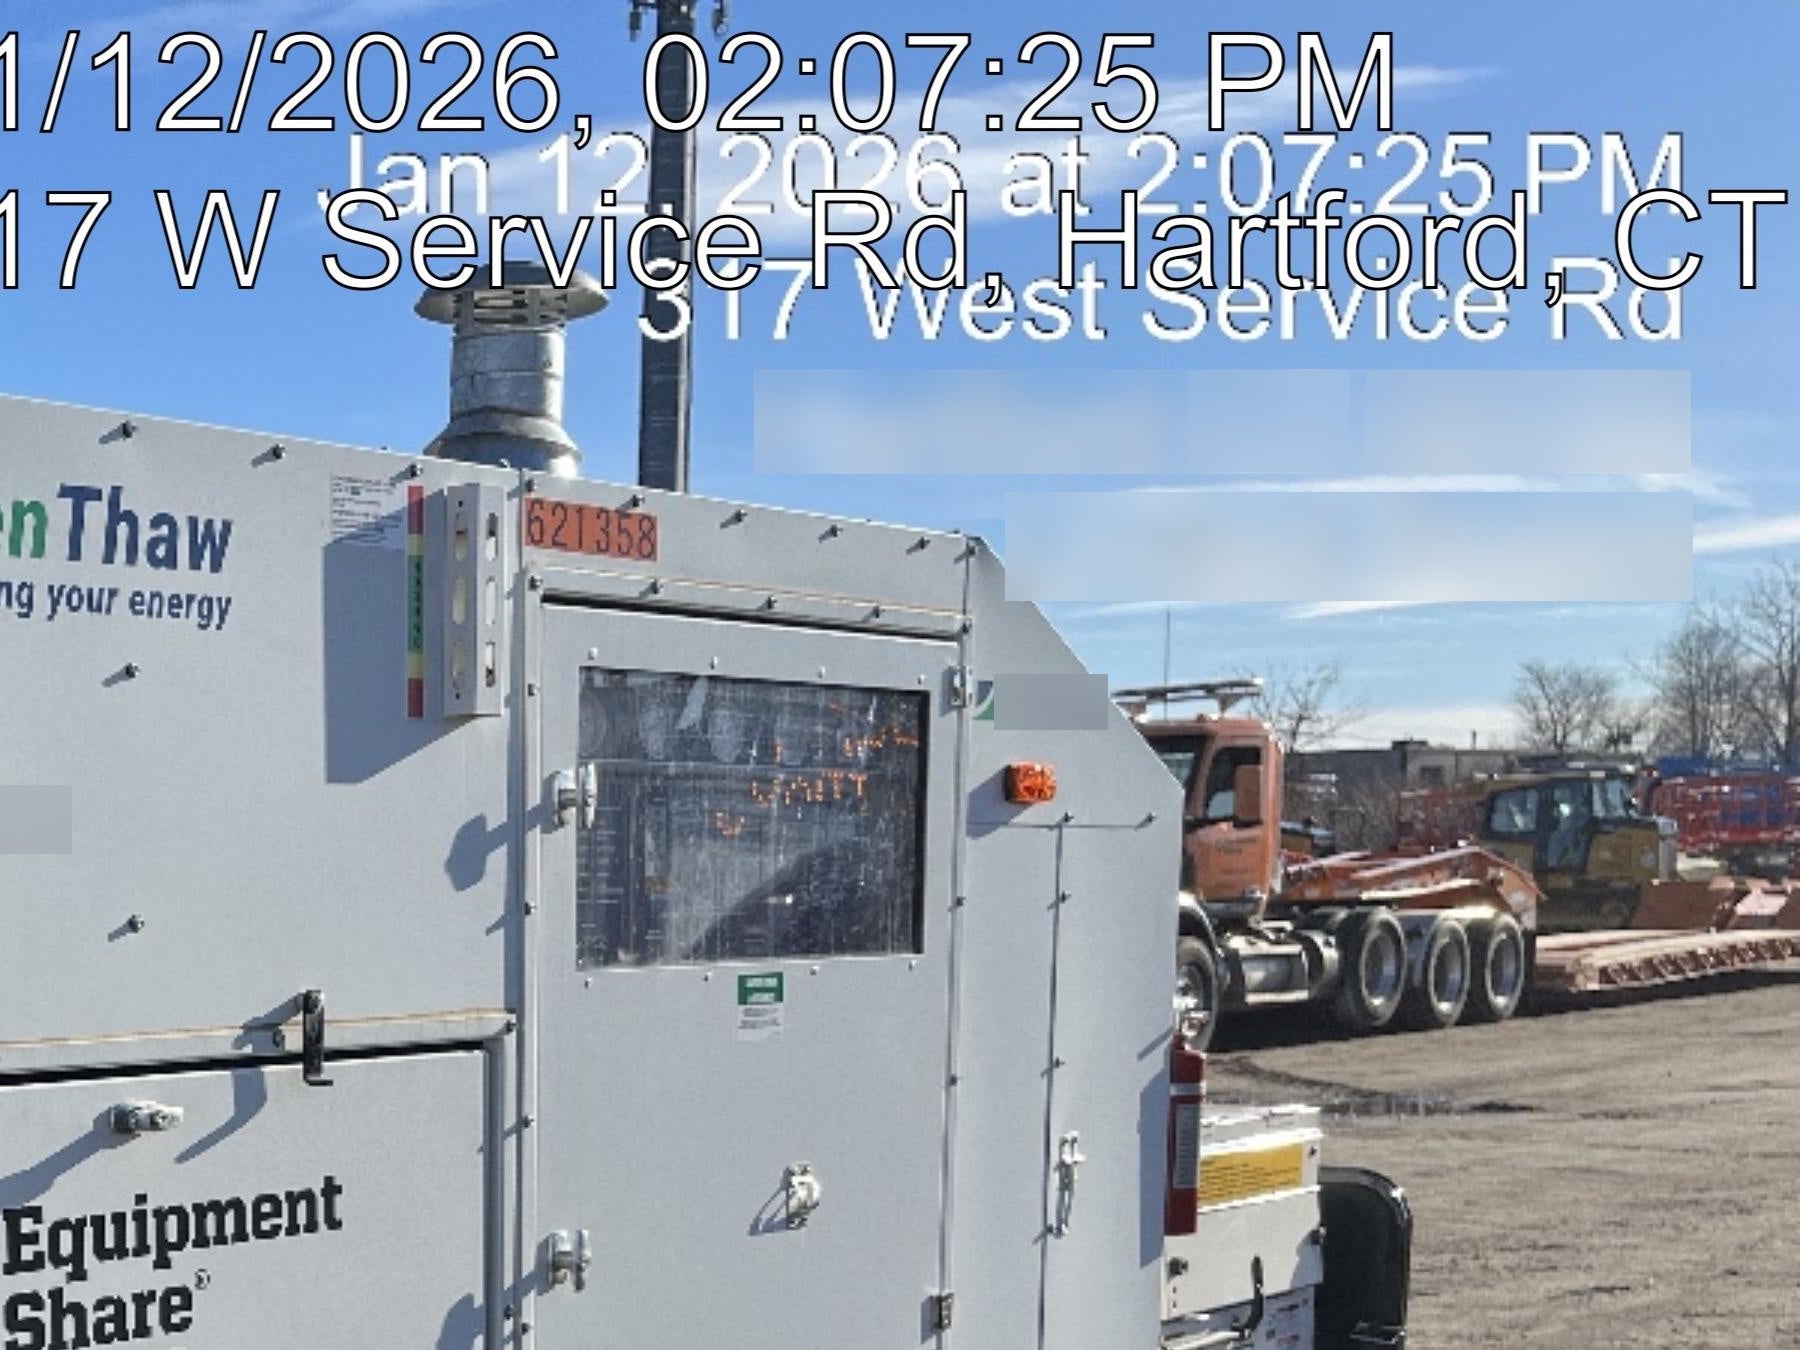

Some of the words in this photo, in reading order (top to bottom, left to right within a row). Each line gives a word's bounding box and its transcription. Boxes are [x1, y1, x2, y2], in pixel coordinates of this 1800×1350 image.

[527, 498, 656, 560] 621358
[45, 580, 120, 622] your
[129, 589, 232, 630] energy
[1, 1175, 343, 1282] Equipment
